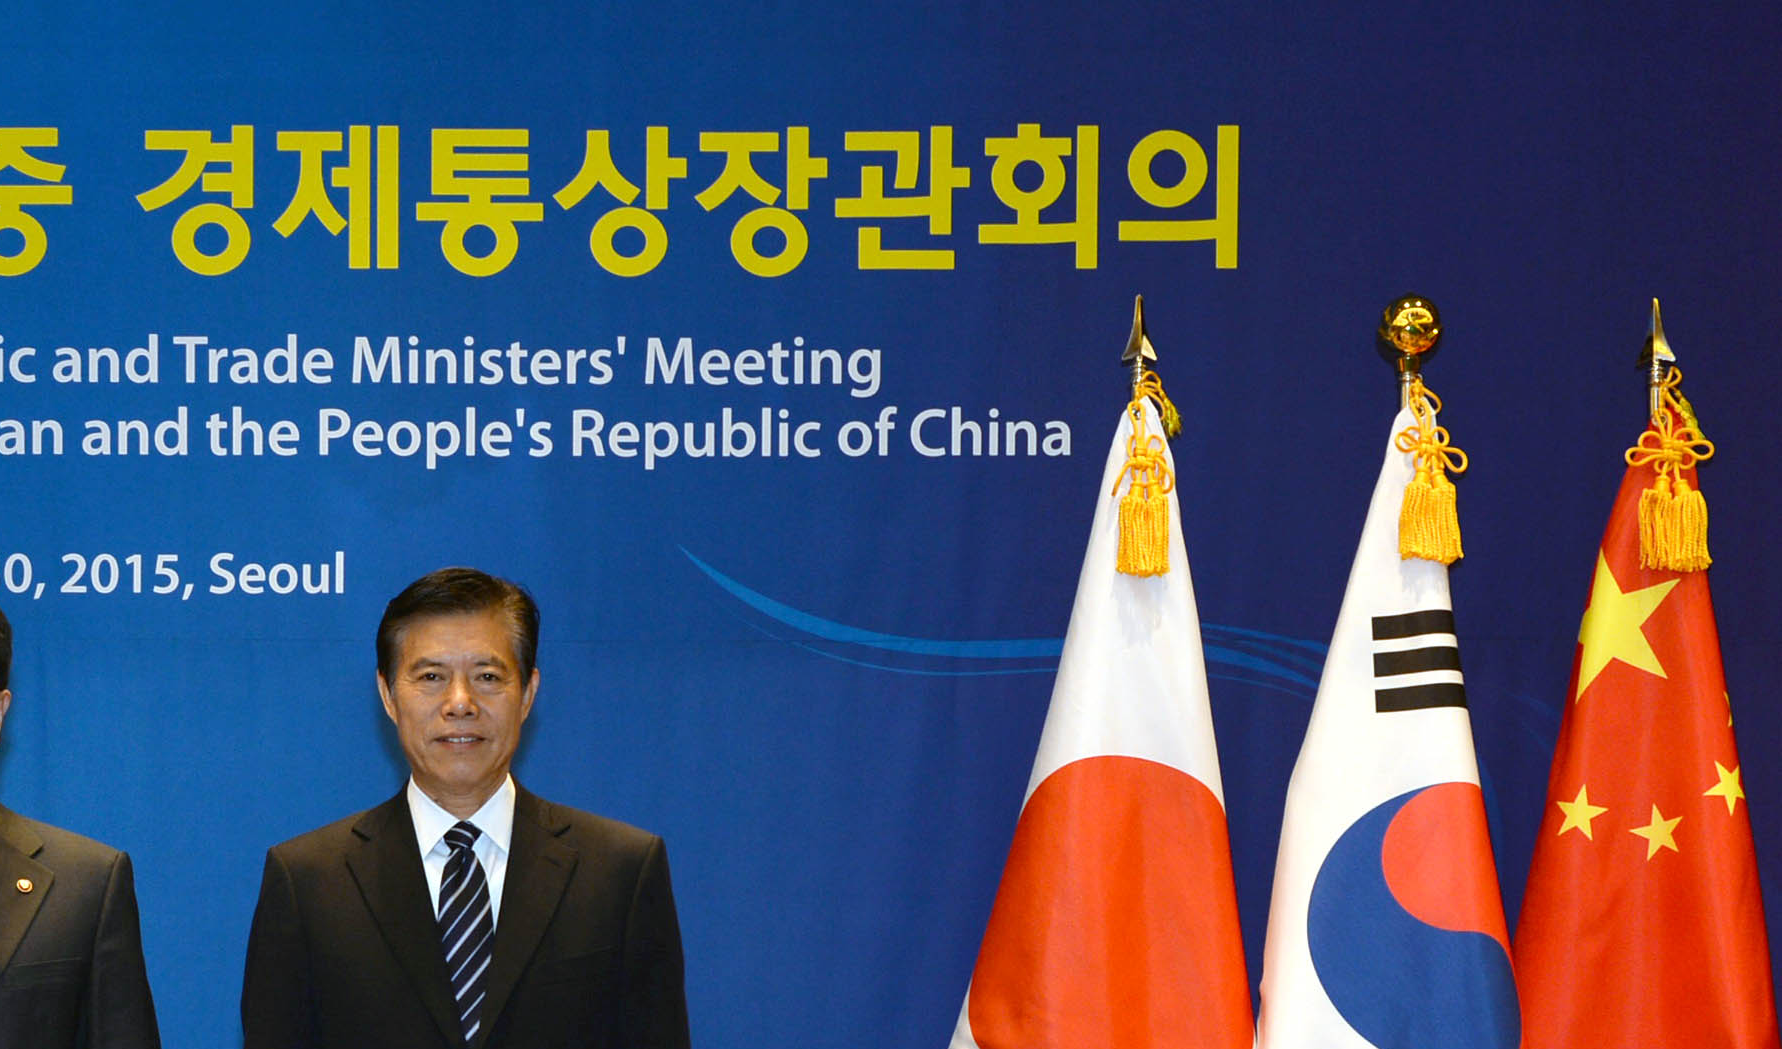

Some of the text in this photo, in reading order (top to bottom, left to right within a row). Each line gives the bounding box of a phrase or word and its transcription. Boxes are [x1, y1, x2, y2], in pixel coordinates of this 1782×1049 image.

[137, 123, 1240, 278] 경제통상장관회의
[52, 333, 159, 384] and
[172, 333, 334, 384] Trade
[352, 335, 626, 385] Ministers'
[644, 336, 881, 398] Meeting
[82, 406, 188, 456] and
[205, 406, 300, 457] the
[319, 406, 553, 470] People's
[572, 407, 821, 470] Republic
[837, 406, 898, 457] of
[910, 406, 1071, 457] China
[60, 553, 195, 601] 2015,
[209, 550, 345, 595] Seoul
